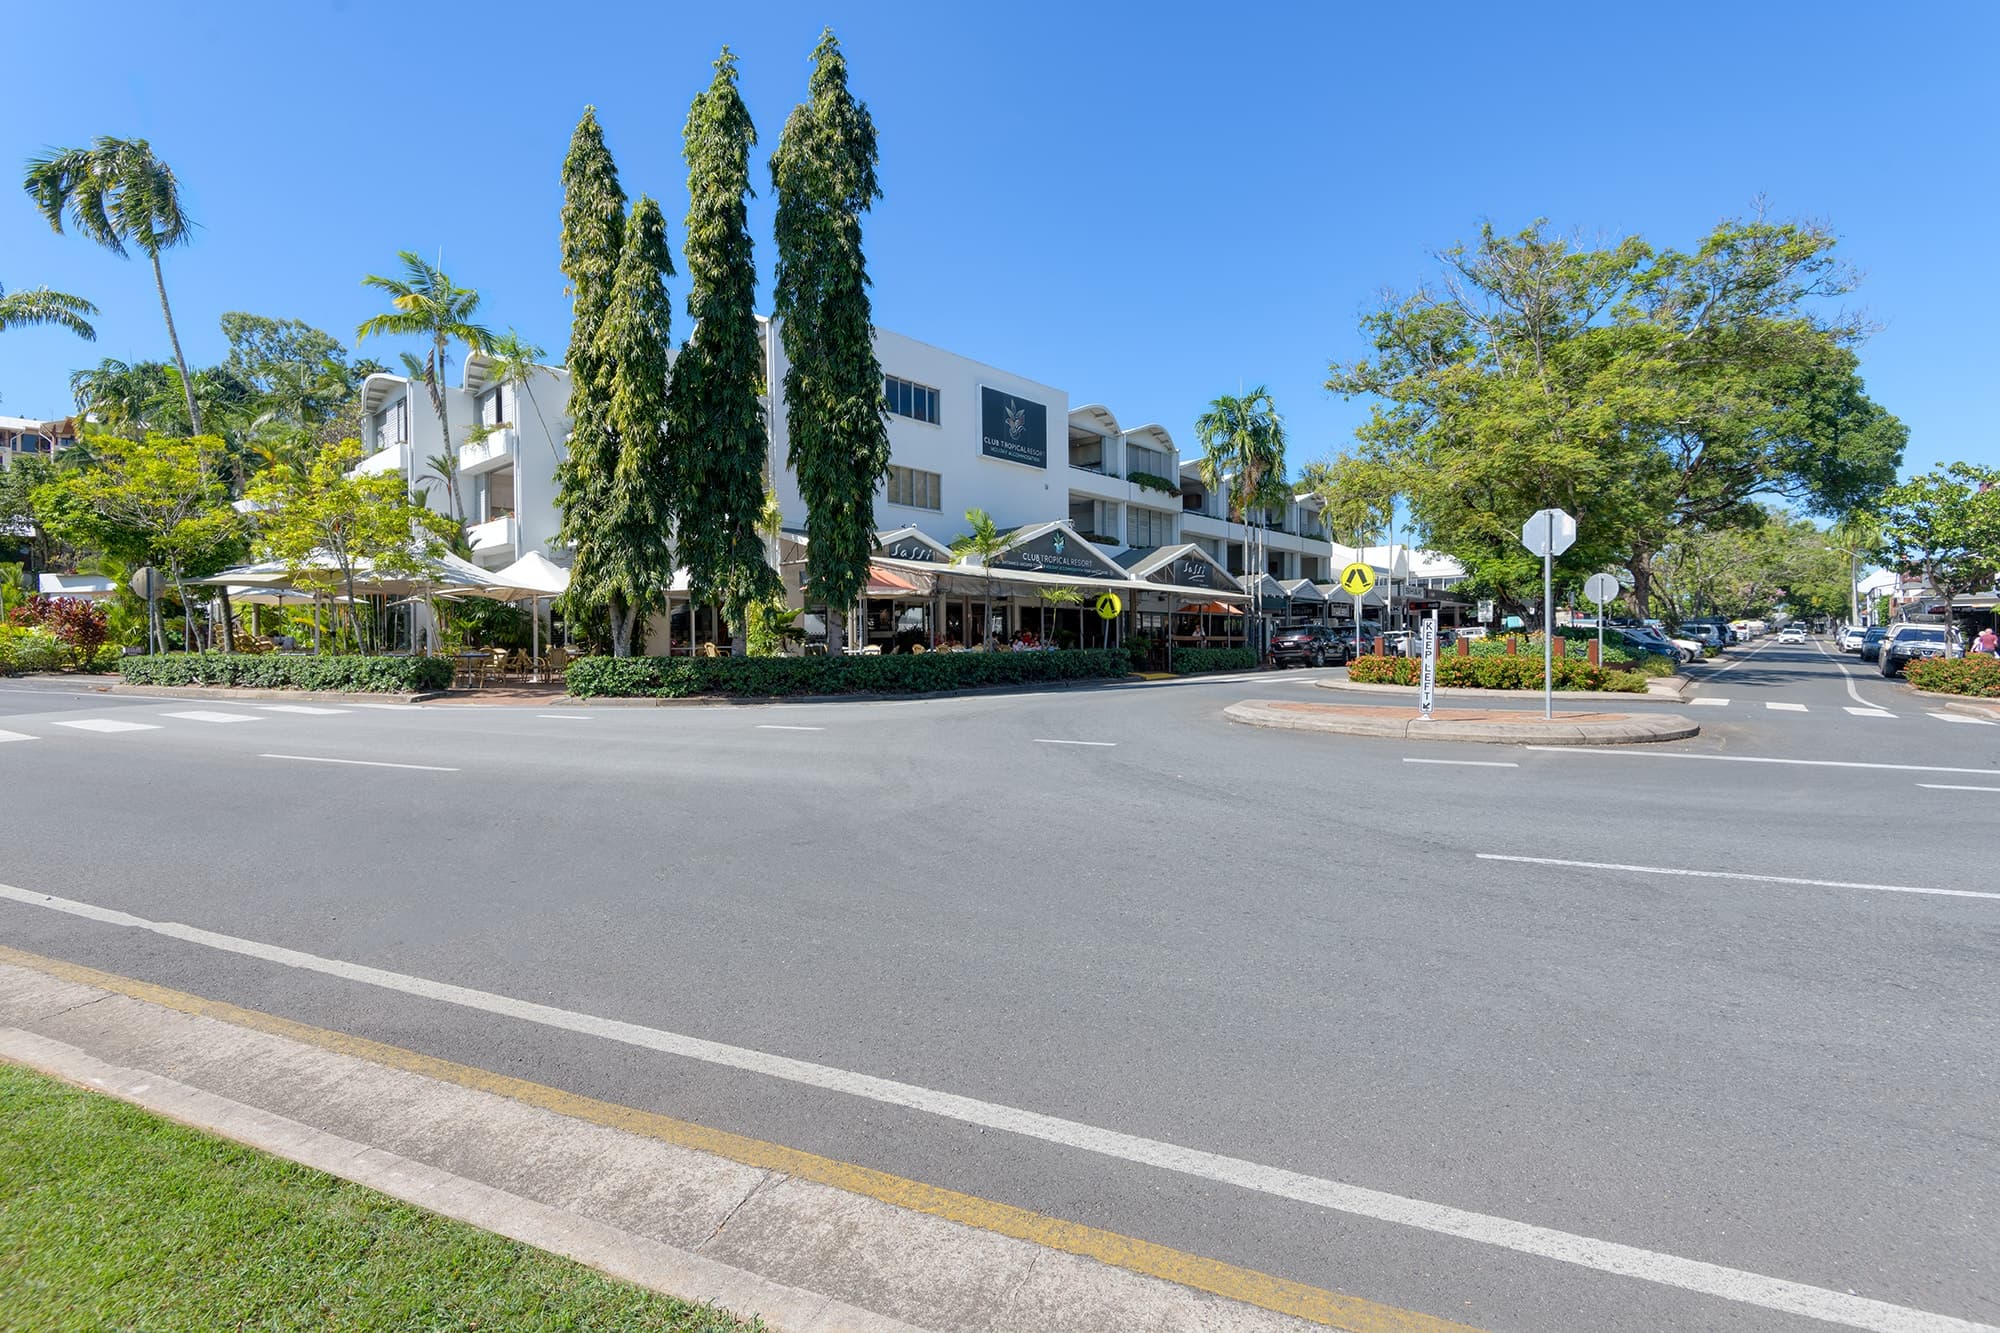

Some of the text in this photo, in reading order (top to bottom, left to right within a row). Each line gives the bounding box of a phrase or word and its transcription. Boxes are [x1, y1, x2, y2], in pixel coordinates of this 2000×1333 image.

[984, 436, 1045, 457] CLUB TROPICAL RESO
[1022, 552, 1040, 562] CLUB
[1041, 555, 1070, 566] TROPICAL
[1070, 559, 1092, 568] RESORT
[1425, 622, 1433, 659] KEEP
